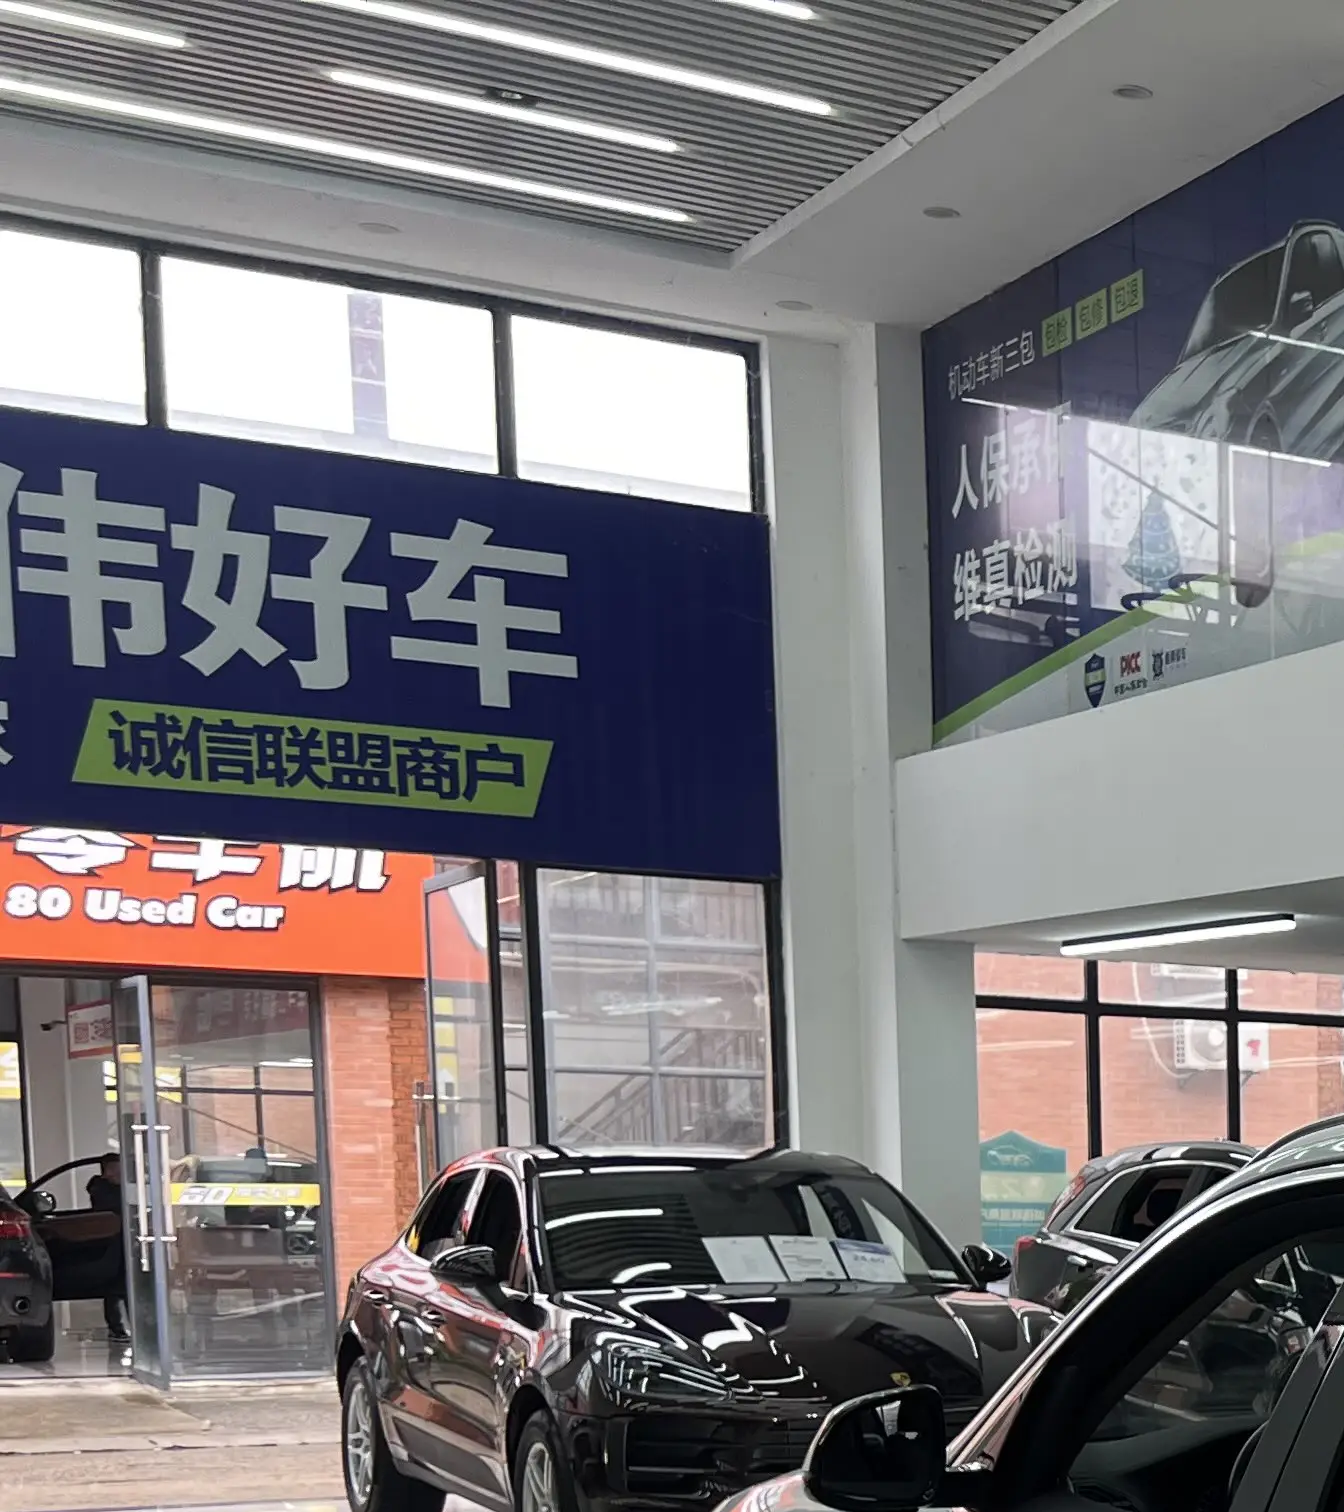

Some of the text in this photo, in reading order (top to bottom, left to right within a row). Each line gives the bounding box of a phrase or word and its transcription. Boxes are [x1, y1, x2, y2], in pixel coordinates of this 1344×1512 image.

[948, 329, 1036, 401] 机动车新三包
[953, 515, 1079, 621] 维真检测
[108, 710, 525, 802] 诚信联盟商户
[5, 884, 286, 931] 80 Used Car
